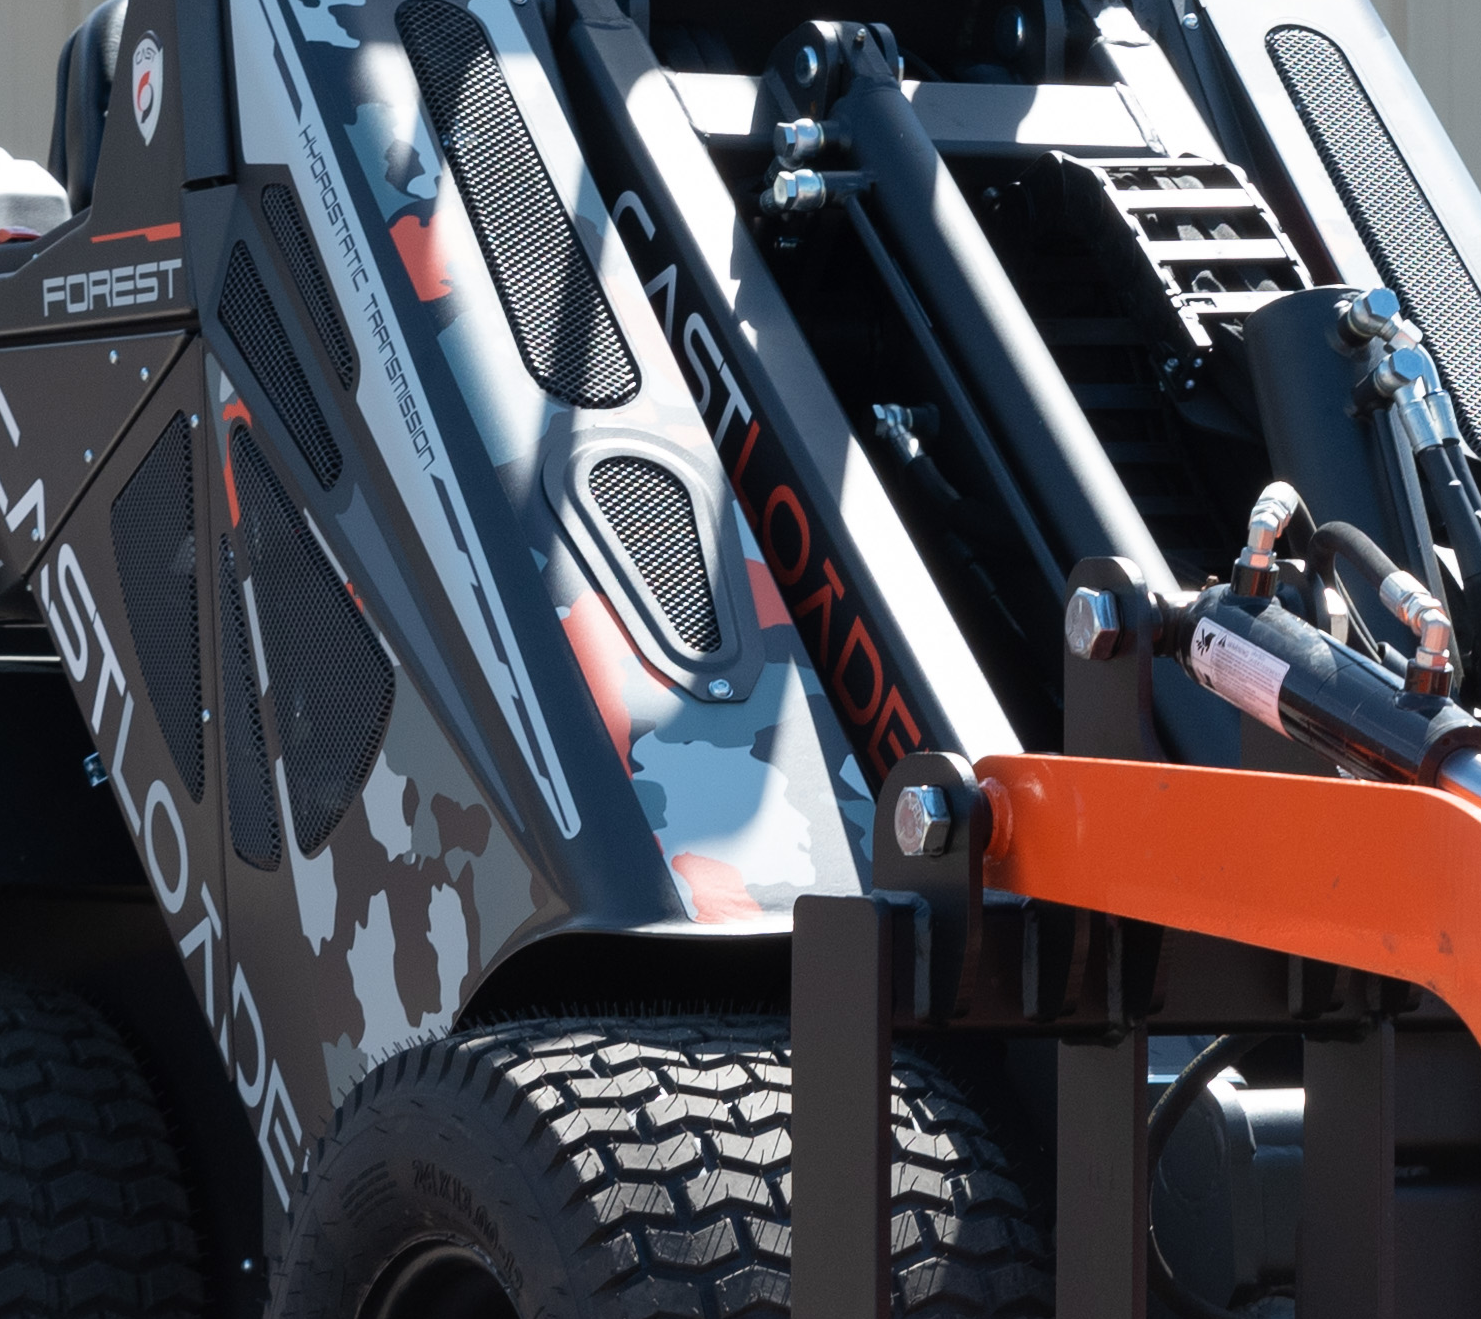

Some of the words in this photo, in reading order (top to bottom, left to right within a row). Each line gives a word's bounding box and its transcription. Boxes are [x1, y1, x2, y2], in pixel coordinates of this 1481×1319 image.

[42, 258, 183, 318] FOREST
[299, 125, 369, 292] HYDROSTATIC
[363, 292, 436, 471] TRANSMISSION
[611, 189, 931, 780] CASTLOADE
